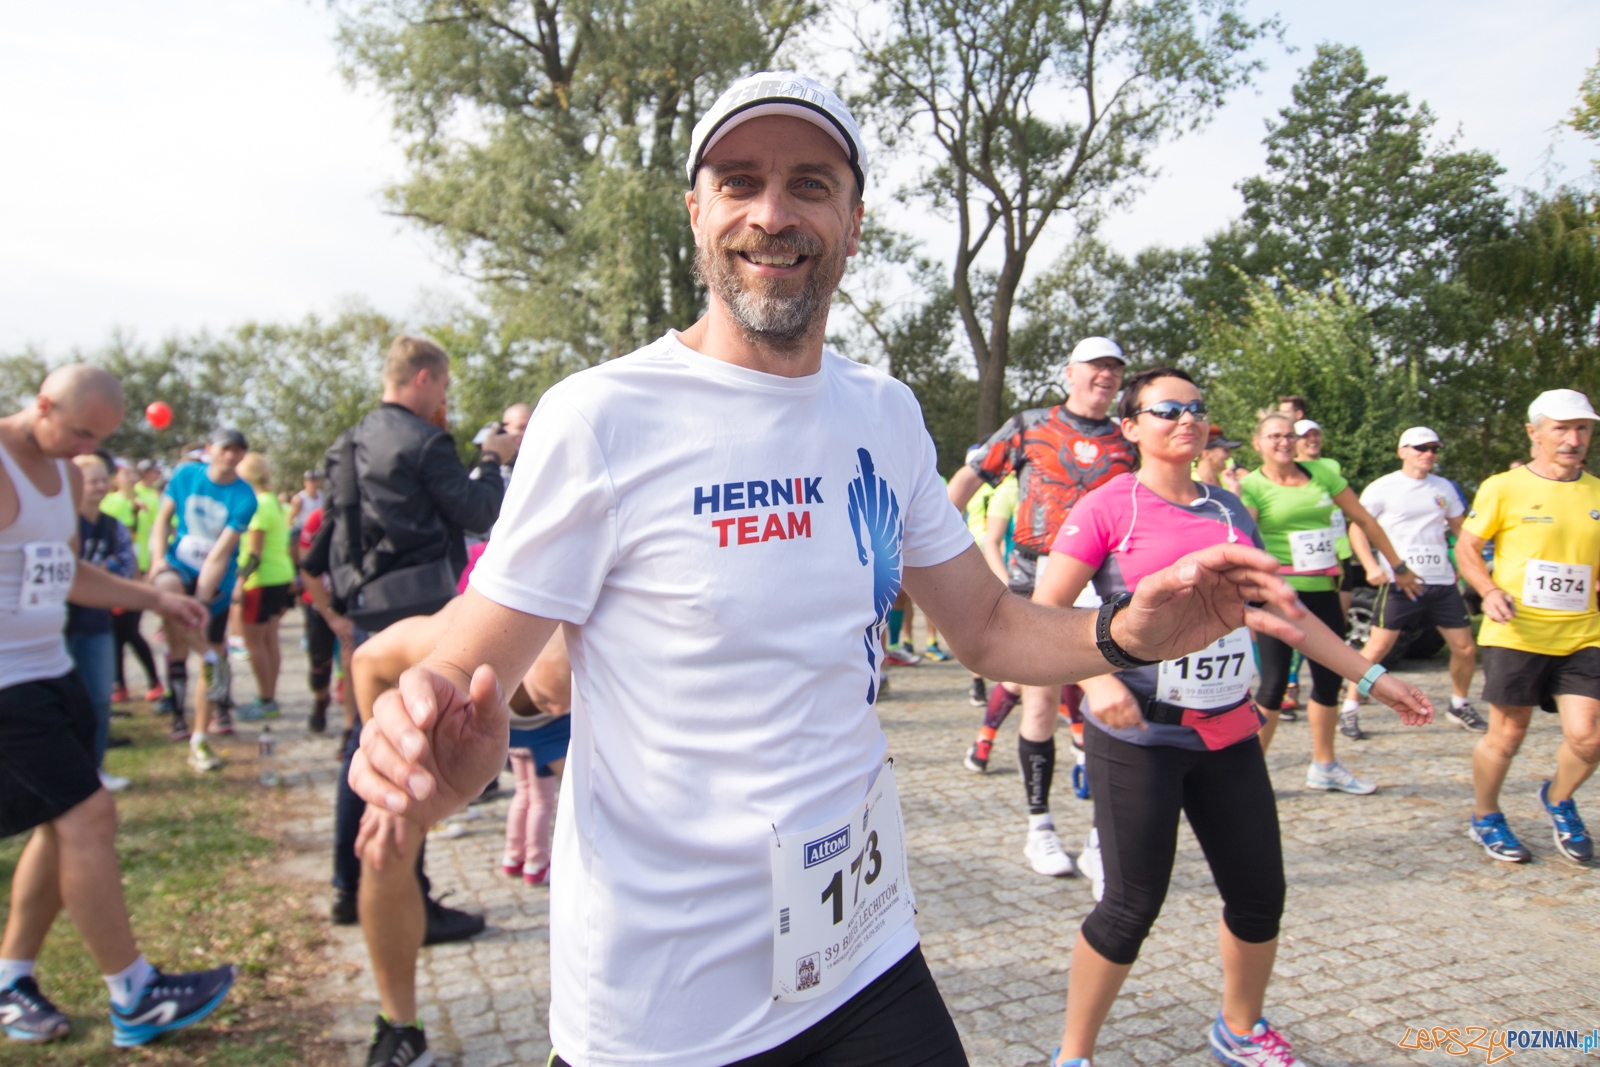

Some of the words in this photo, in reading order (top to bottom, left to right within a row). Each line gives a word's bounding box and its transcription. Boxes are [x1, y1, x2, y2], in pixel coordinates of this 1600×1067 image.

[693, 476, 824, 515] HERNIK
[711, 511, 811, 548] TEAM
[1408, 555, 1441, 565] 1070
[1536, 576, 1585, 594] 1874
[1175, 652, 1245, 680] 1577
[821, 830, 882, 925] 173
[824, 943, 840, 961] 39
[842, 921, 859, 952] BIEG
[859, 877, 899, 927] LECHITÓW
